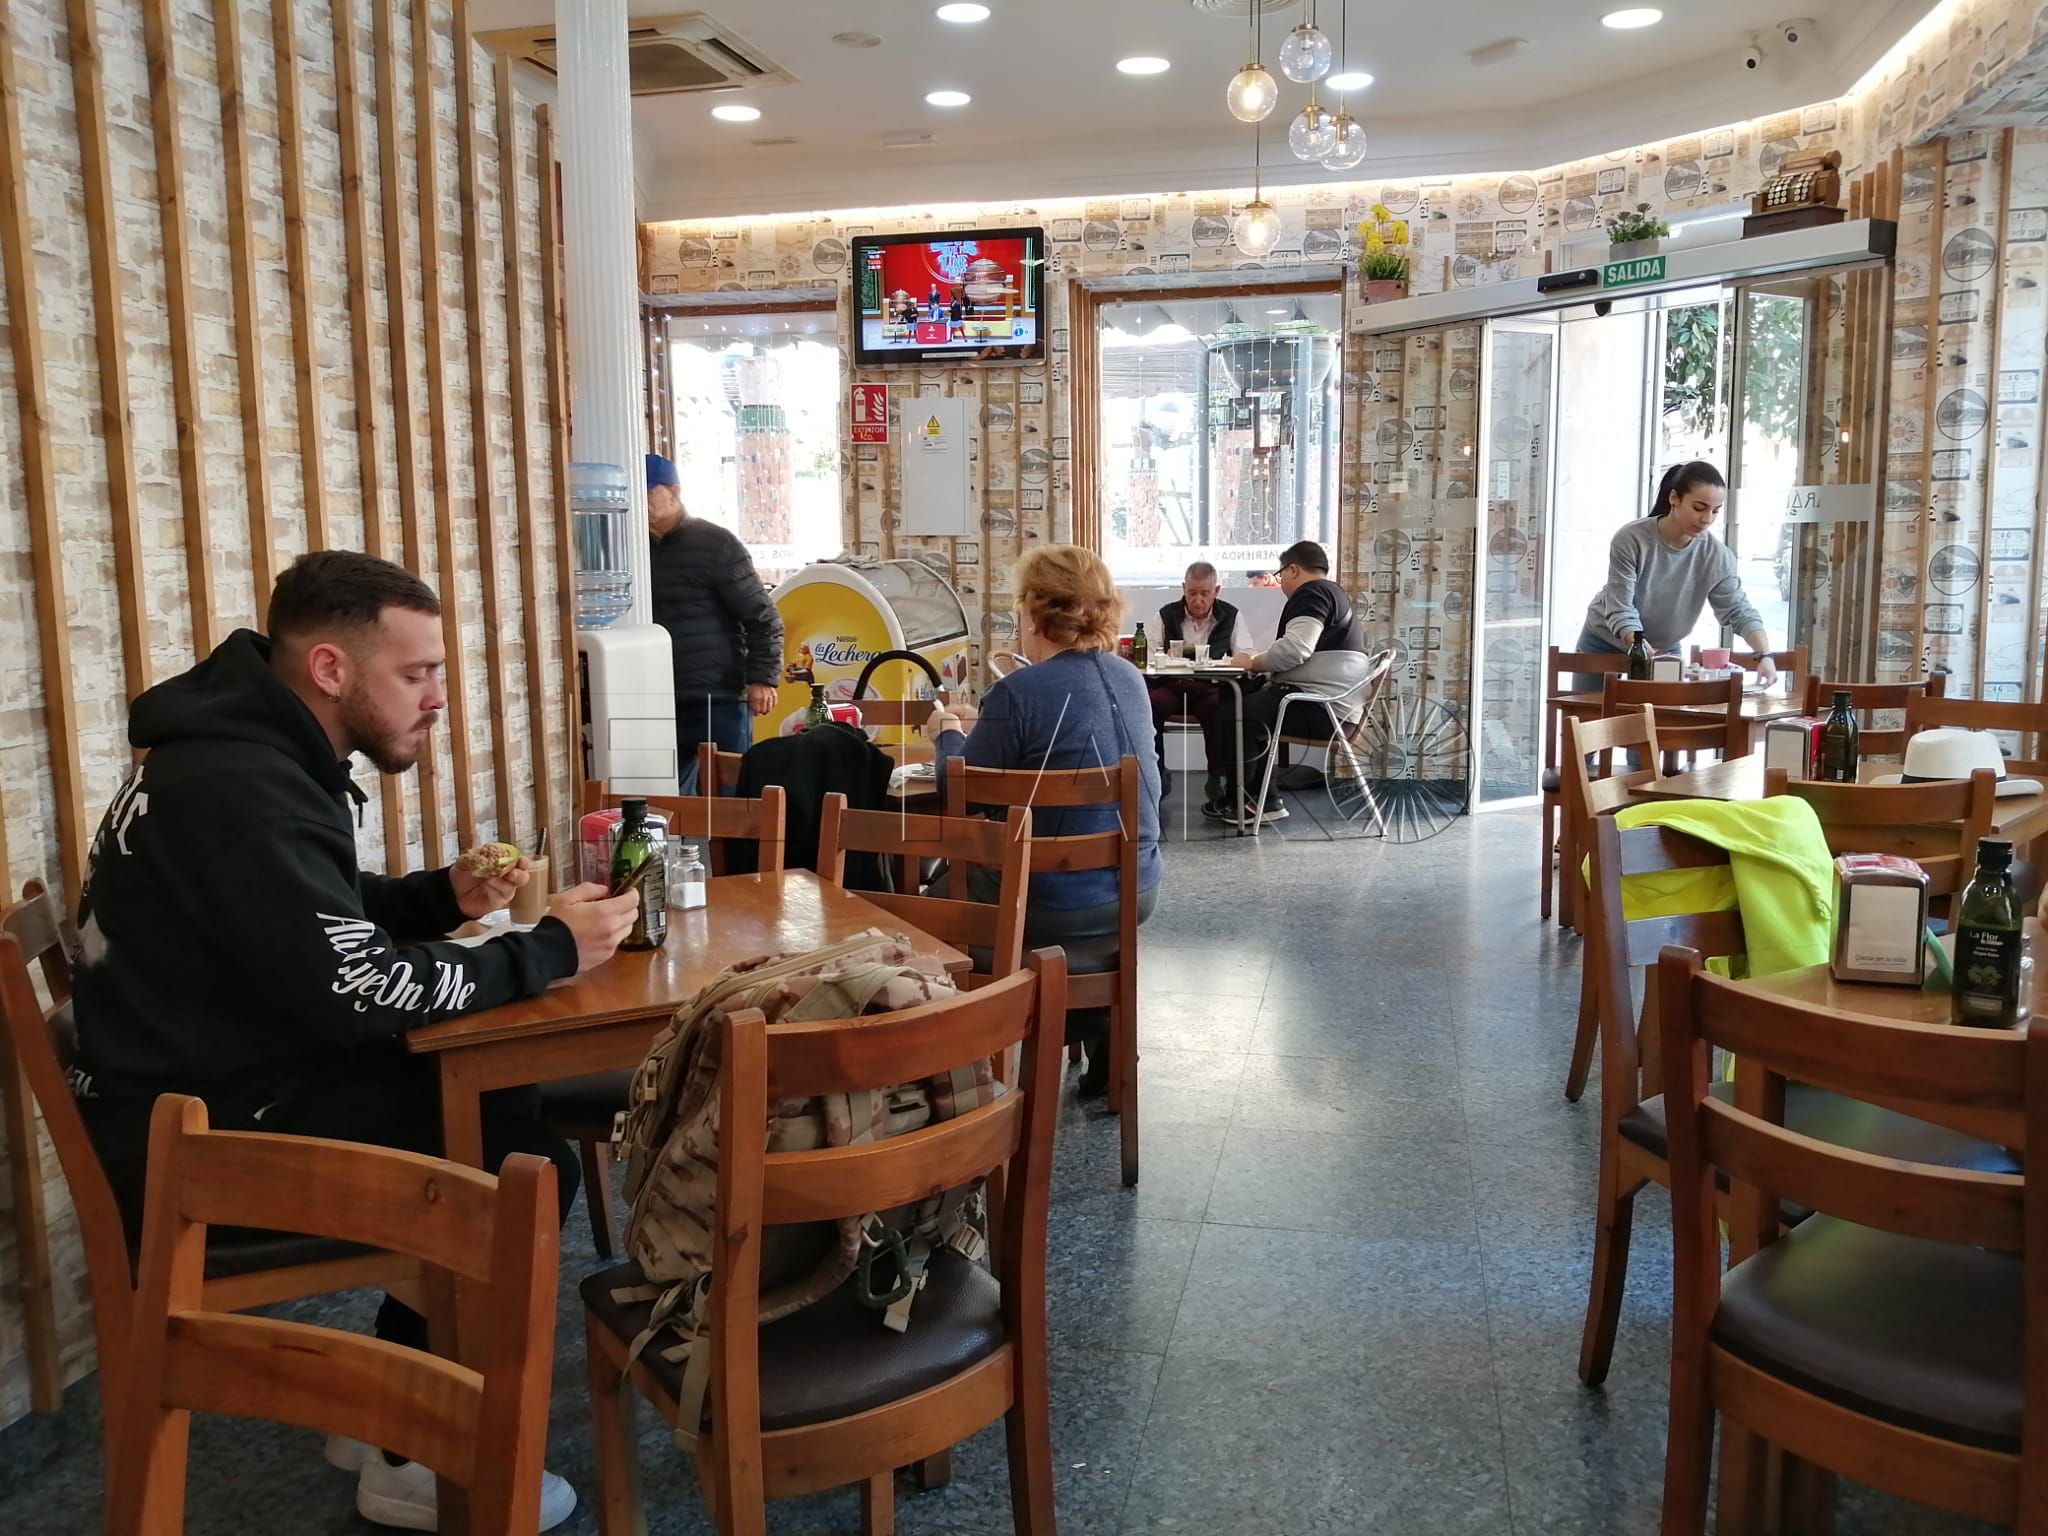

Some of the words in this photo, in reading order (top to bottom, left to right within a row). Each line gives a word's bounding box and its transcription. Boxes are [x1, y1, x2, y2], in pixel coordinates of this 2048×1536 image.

[1607, 259, 1661, 283] SALIDA
[853, 426, 885, 434] EXTINTOR
[1969, 930, 1980, 939] La
[1981, 931, 1999, 942] Flor
[423, 960, 477, 1013] Me
